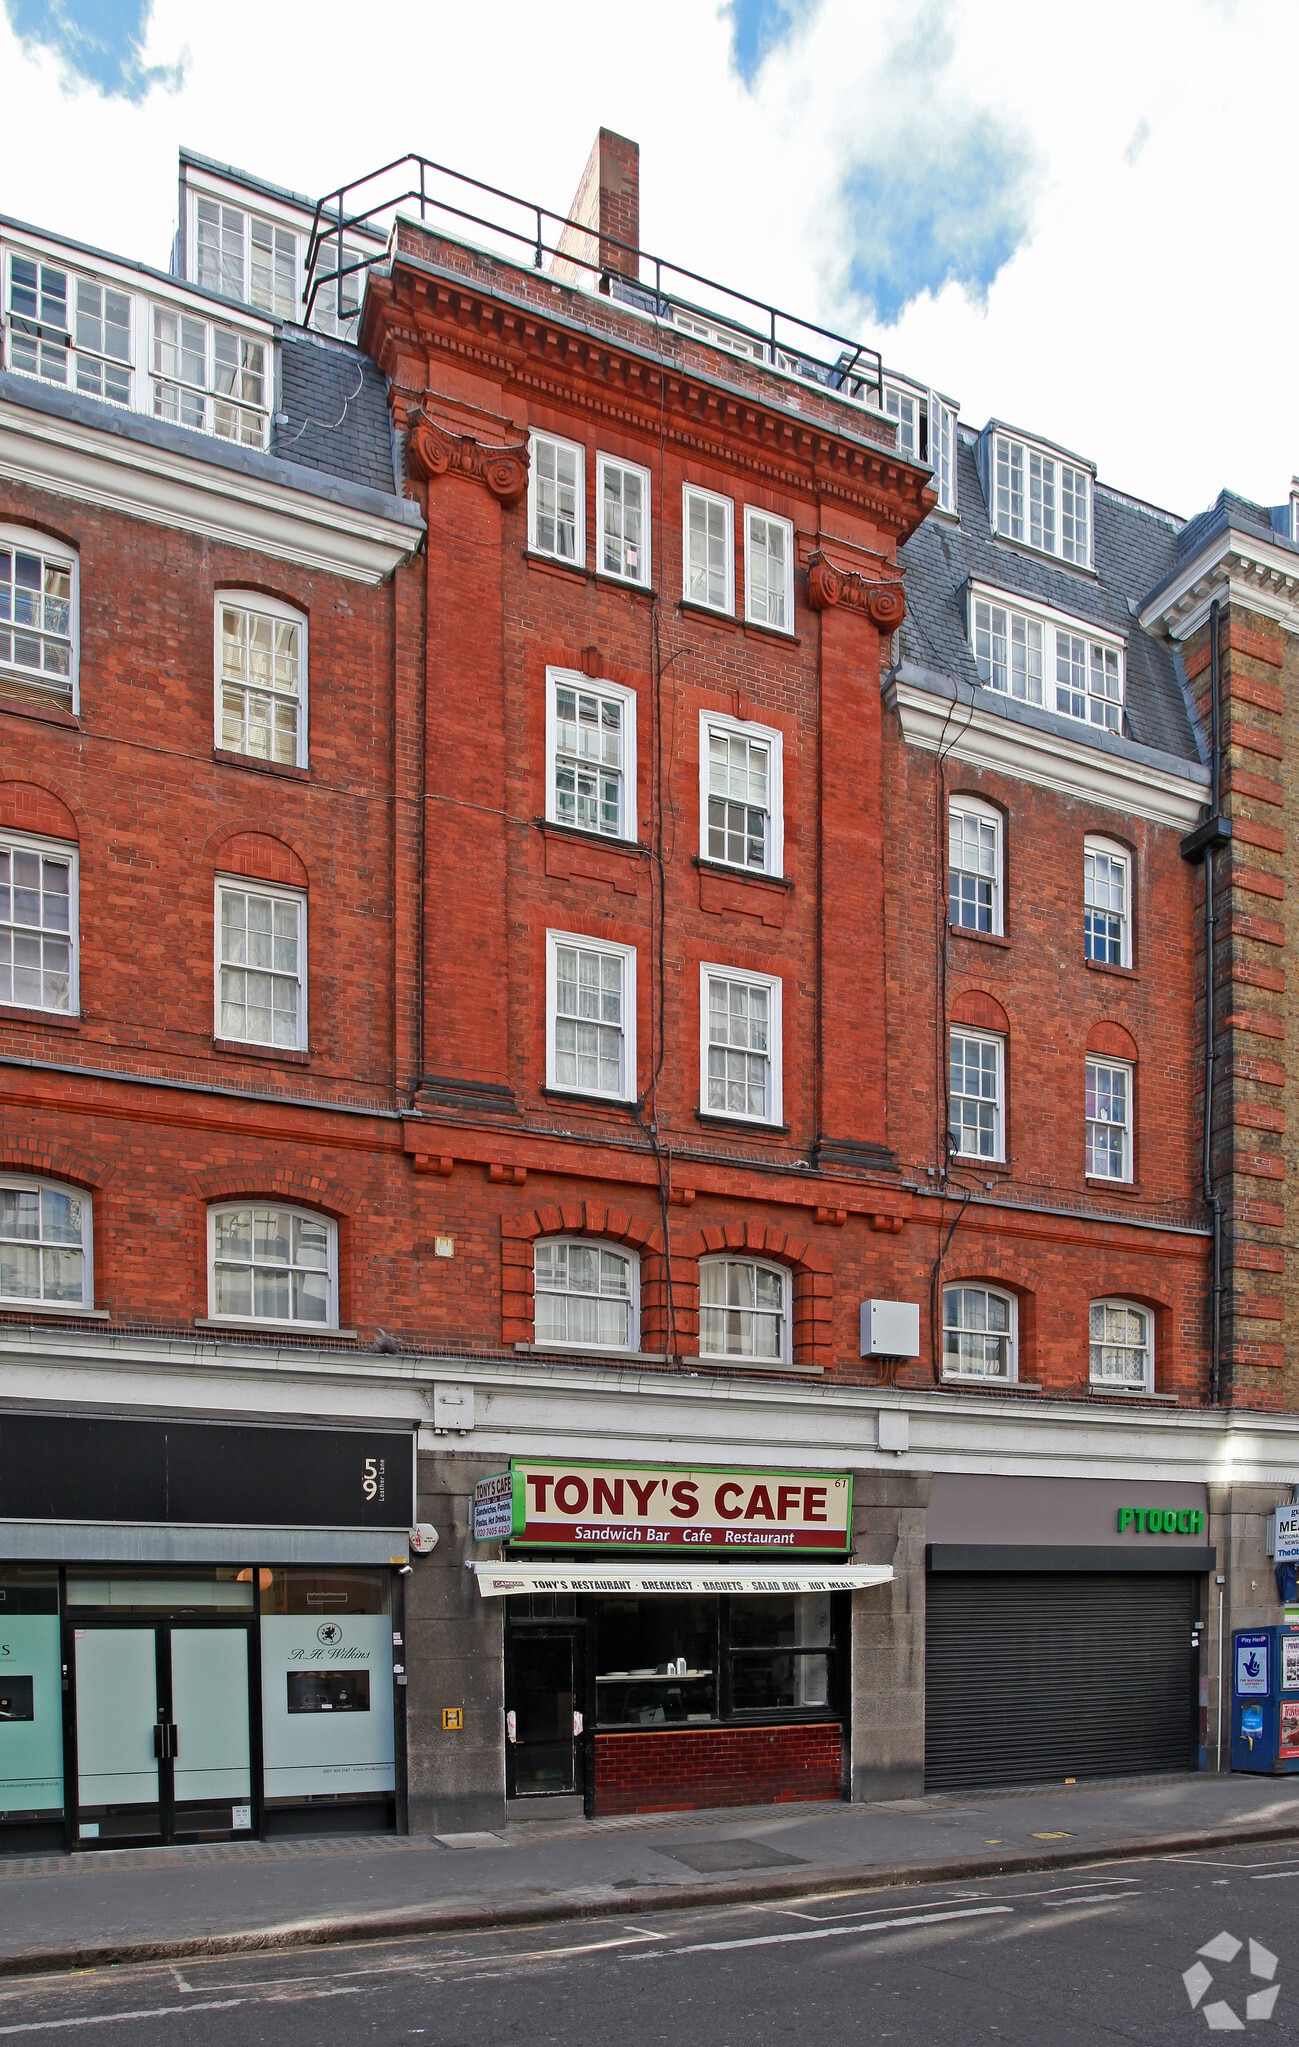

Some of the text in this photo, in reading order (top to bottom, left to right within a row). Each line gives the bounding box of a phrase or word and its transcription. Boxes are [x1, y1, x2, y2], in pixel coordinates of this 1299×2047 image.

[496, 1476, 511, 1494] CAFE
[834, 1479, 846, 1488] 61
[527, 1474, 827, 1522] TONY'S CAFE
[1118, 1507, 1204, 1533] PTOOCH
[1280, 1520, 1299, 1532] ME
[575, 1526, 794, 1544] Sandwich Bar Cafe Restaurant
[532, 1580, 568, 1590] TONY'S
[571, 1580, 630, 1590] RESTAURANT
[642, 1580, 692, 1590] BREAKFAST
[702, 1581, 744, 1590] BAGUETS
[752, 1582, 777, 1590] SALAD
[781, 1582, 800, 1590] BOX
[808, 1582, 826, 1590] HOT
[328, 1646, 370, 1660] Wilkins
